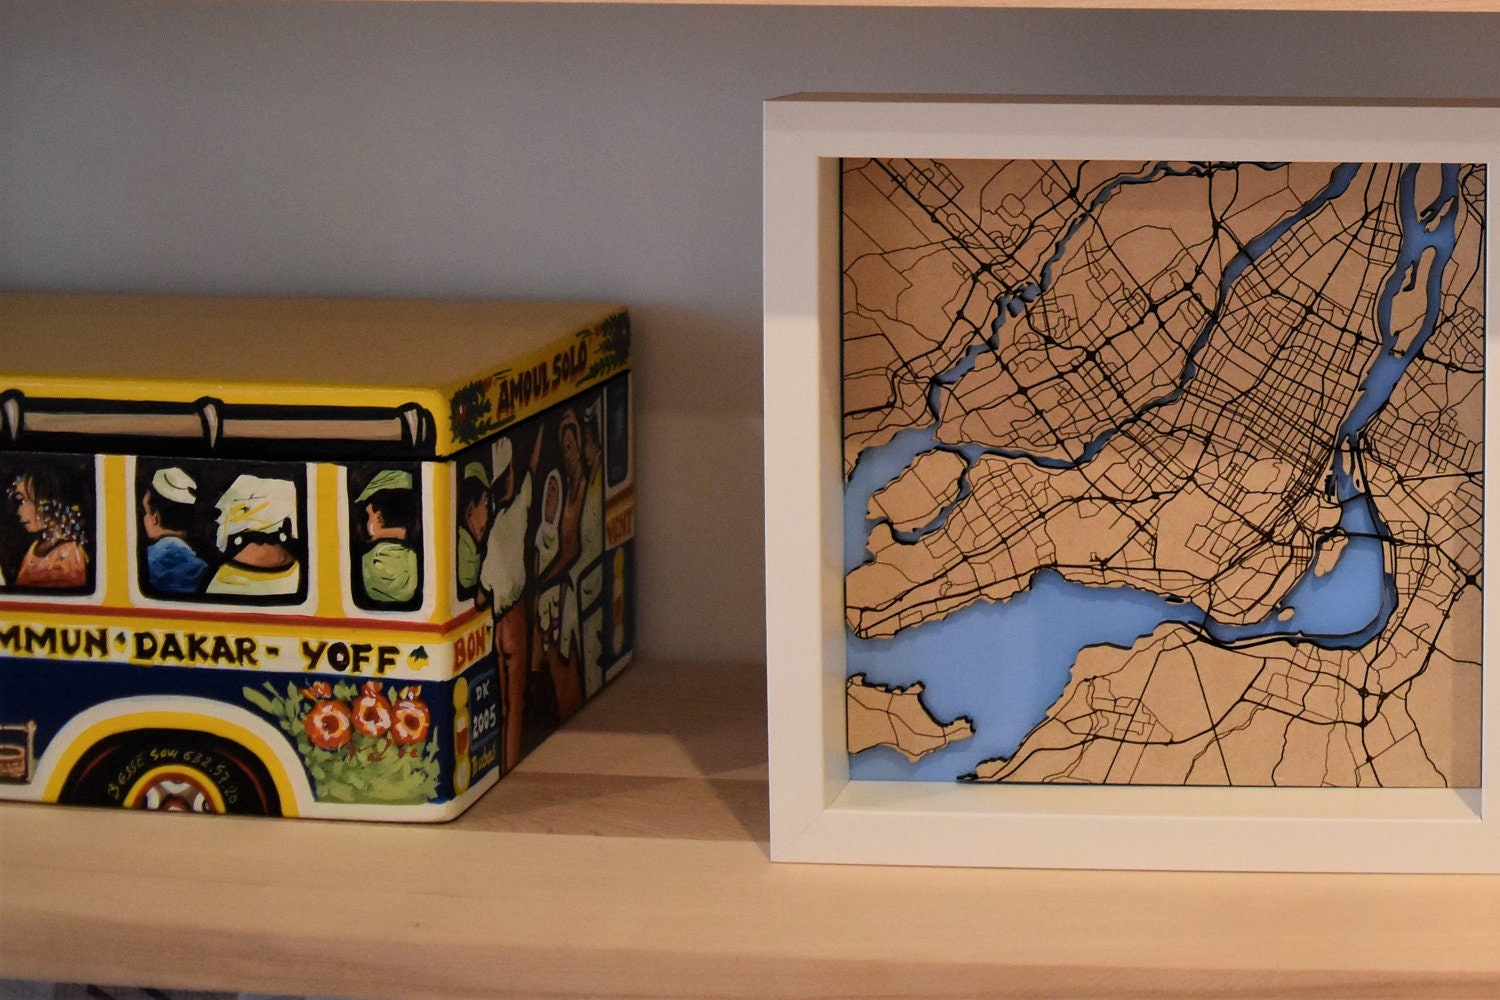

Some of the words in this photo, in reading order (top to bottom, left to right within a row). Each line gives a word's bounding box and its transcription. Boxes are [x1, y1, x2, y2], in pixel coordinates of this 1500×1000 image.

[552, 341, 588, 392] SOLO
[134, 632, 258, 667] DAKAR
[301, 640, 401, 674] YOFF
[453, 624, 486, 673] BON
[475, 680, 490, 701] DK
[472, 704, 496, 740] 2005
